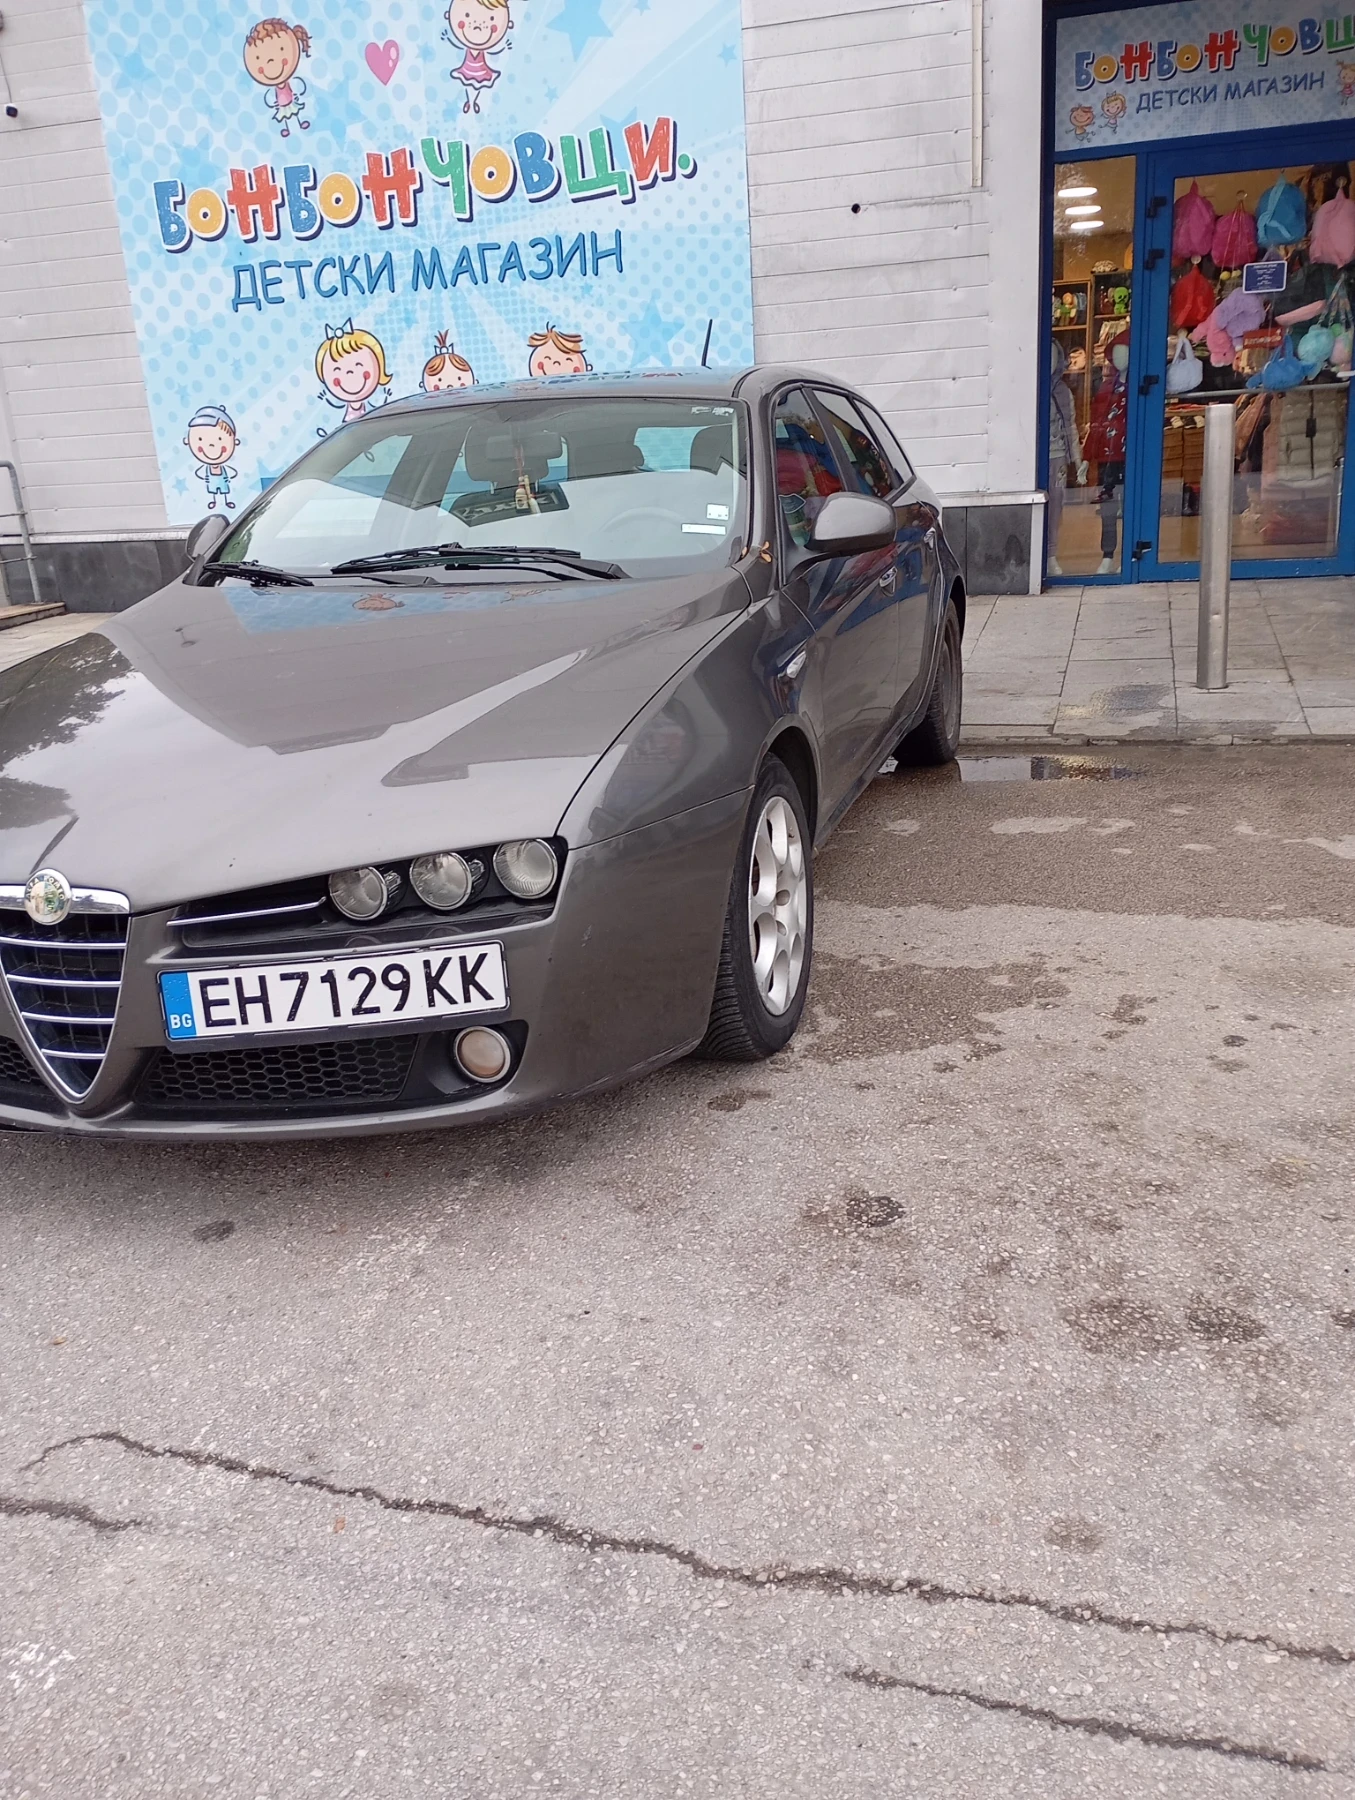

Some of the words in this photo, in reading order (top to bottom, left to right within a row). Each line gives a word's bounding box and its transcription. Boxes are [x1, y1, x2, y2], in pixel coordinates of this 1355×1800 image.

[1136, 84, 1217, 114] ДЕТСКИ
[1224, 71, 1325, 101] МАГАЗИН
[231, 250, 396, 312] ДЕТСКИ
[411, 229, 623, 291] МАГАЗИН
[170, 1013, 192, 1029] BG
